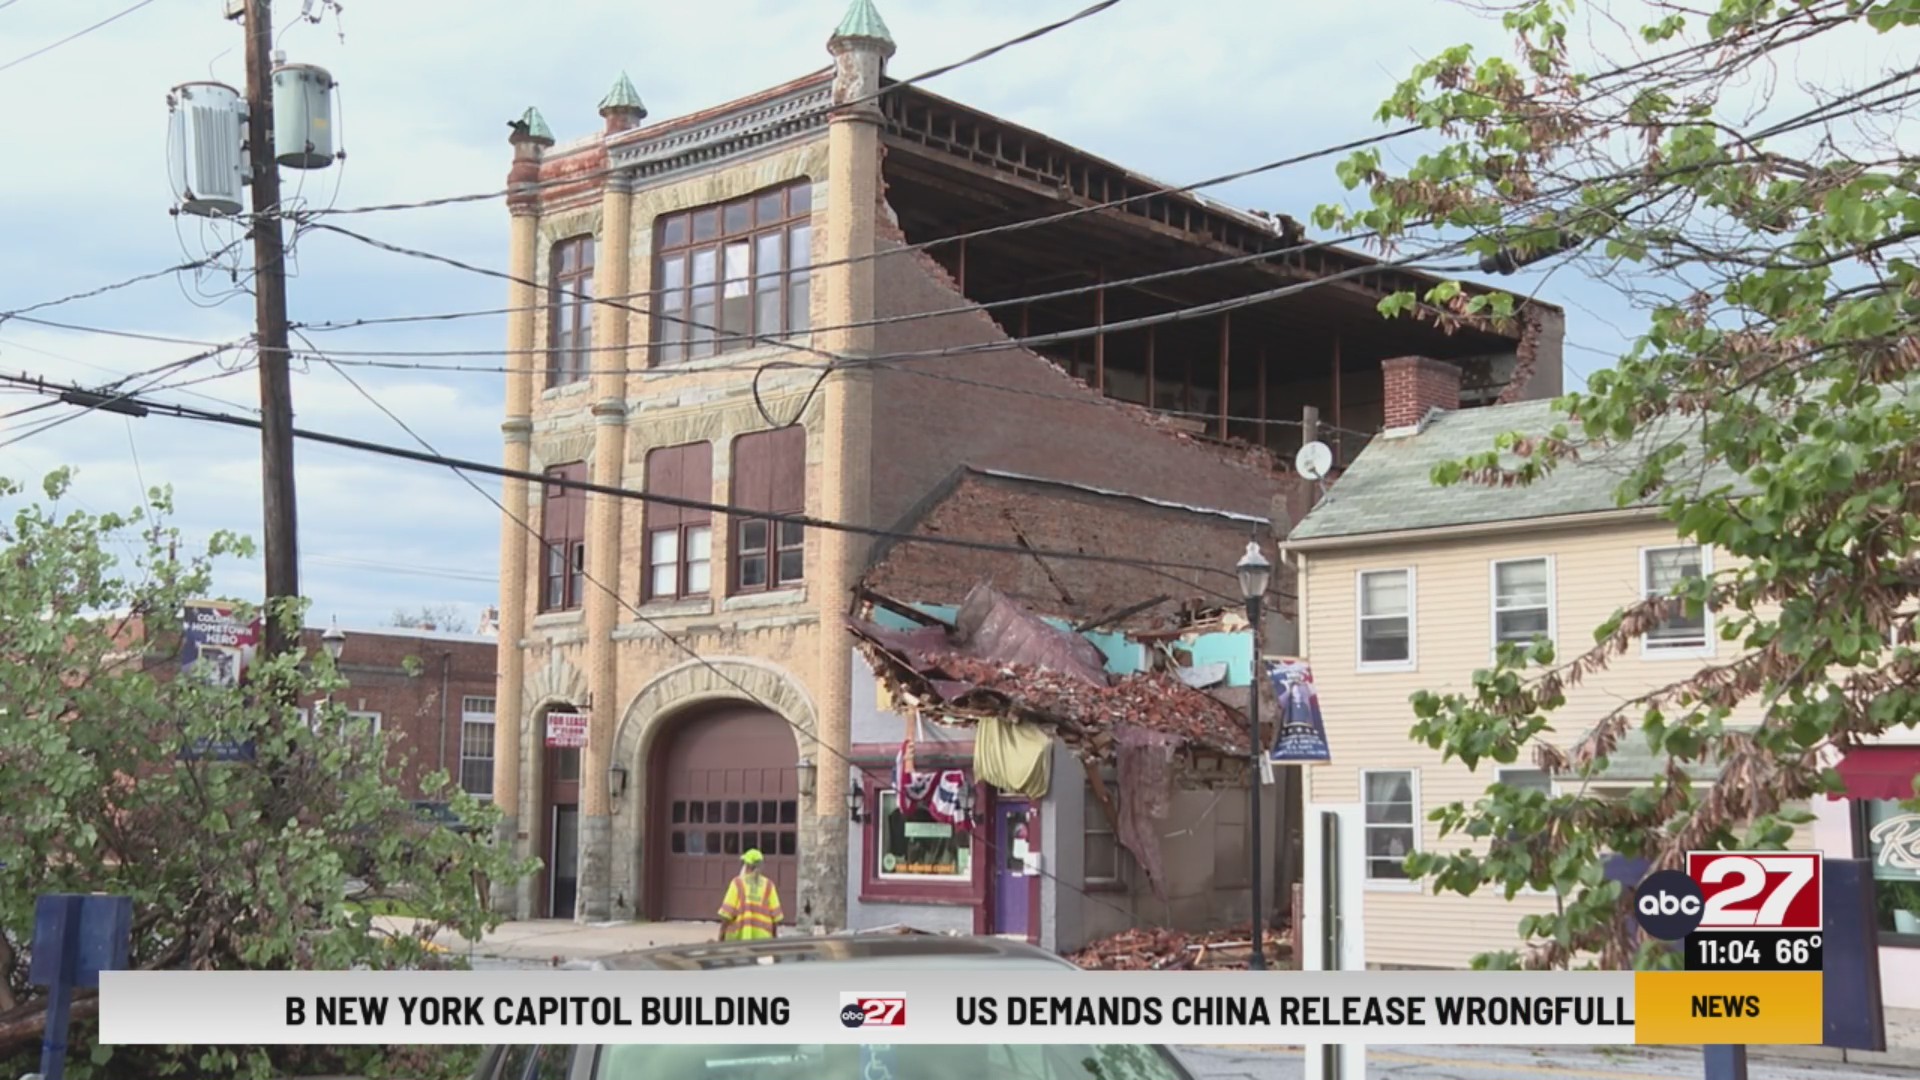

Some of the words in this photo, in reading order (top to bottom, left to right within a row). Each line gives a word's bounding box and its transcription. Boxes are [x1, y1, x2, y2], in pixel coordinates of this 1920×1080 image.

[191, 622, 253, 636] HOMETOWN
[206, 634, 239, 645] HERO
[549, 715, 564, 725] FOR
[565, 716, 588, 728] LEASE
